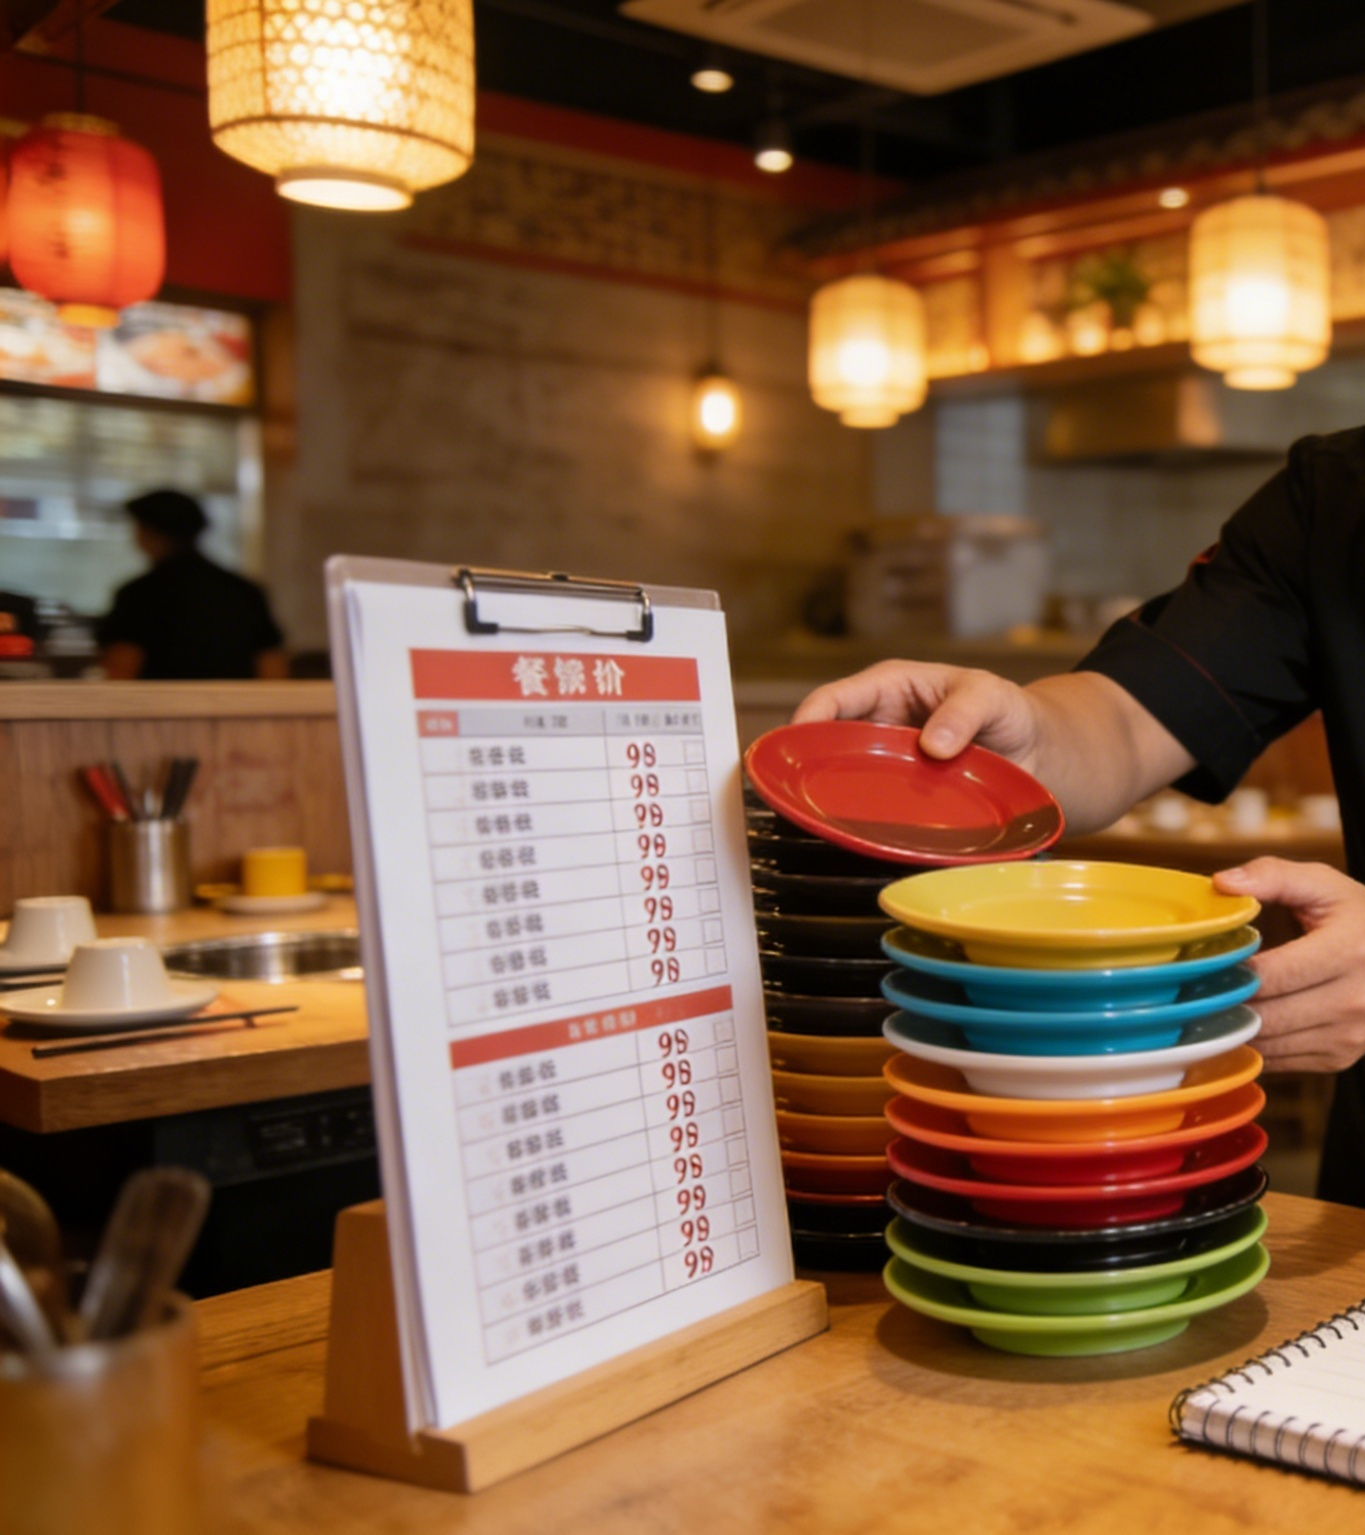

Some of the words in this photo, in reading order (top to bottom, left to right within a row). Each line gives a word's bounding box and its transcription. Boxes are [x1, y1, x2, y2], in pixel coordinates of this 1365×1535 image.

[626, 742, 657, 769] 98
[630, 773, 659, 799] 98
[644, 895, 673, 924] 98
[661, 1058, 692, 1089] 98
